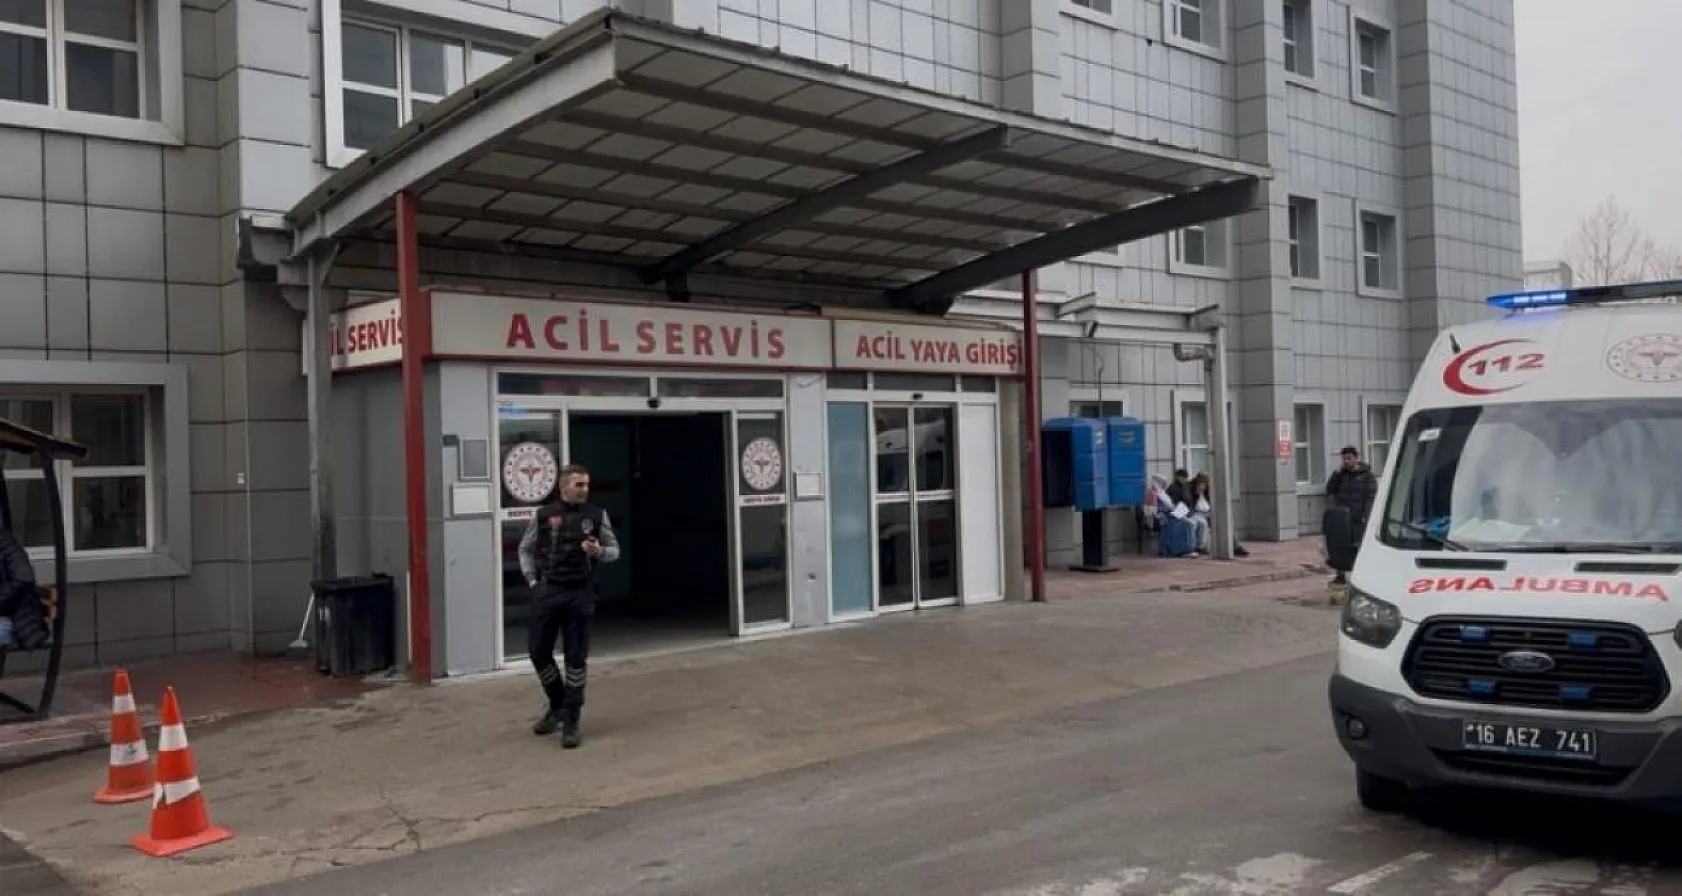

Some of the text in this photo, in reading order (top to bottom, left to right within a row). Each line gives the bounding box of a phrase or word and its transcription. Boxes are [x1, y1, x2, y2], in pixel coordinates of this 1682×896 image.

[506, 308, 786, 359] ACİL SERVİS
[856, 330, 905, 360] ACİL
[910, 338, 961, 363] YAYA
[1467, 353, 1545, 375] 112
[1477, 725, 1590, 752] 16 AEZ 741
